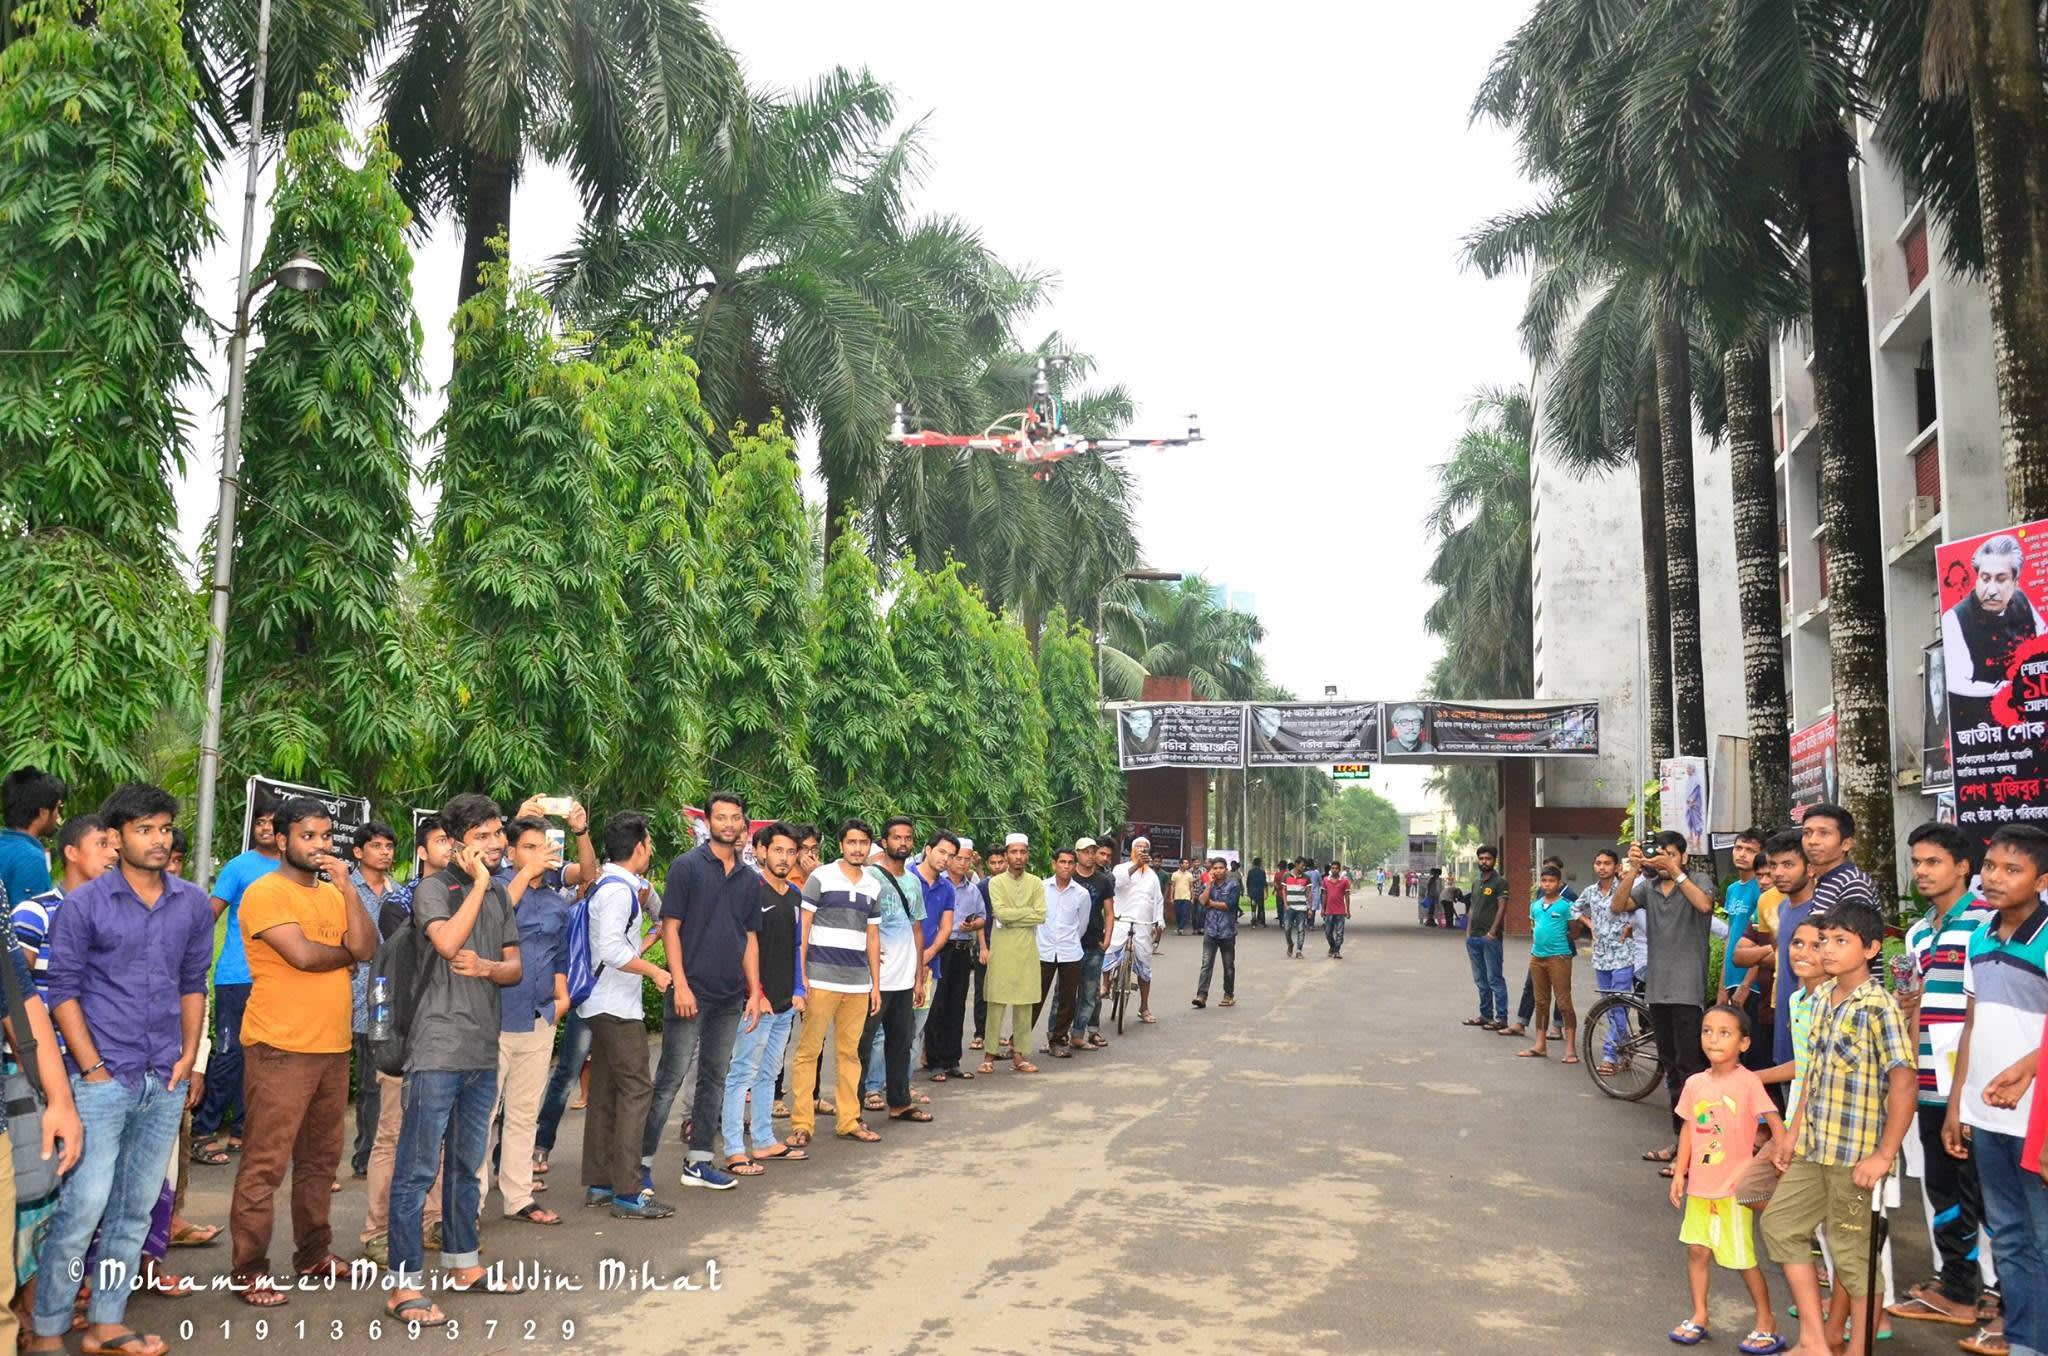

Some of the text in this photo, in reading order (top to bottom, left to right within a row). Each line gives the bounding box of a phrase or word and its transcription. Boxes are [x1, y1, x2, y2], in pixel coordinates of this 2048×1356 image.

[2024, 699, 2048, 712] আগ
[1956, 721, 2046, 747] জাতীয় শোক
[1160, 739, 1187, 751] গভীর
[1960, 783, 1987, 802] শেখ
[1991, 776, 2040, 803] মুজিবুর
[1960, 811, 1977, 823] এবং
